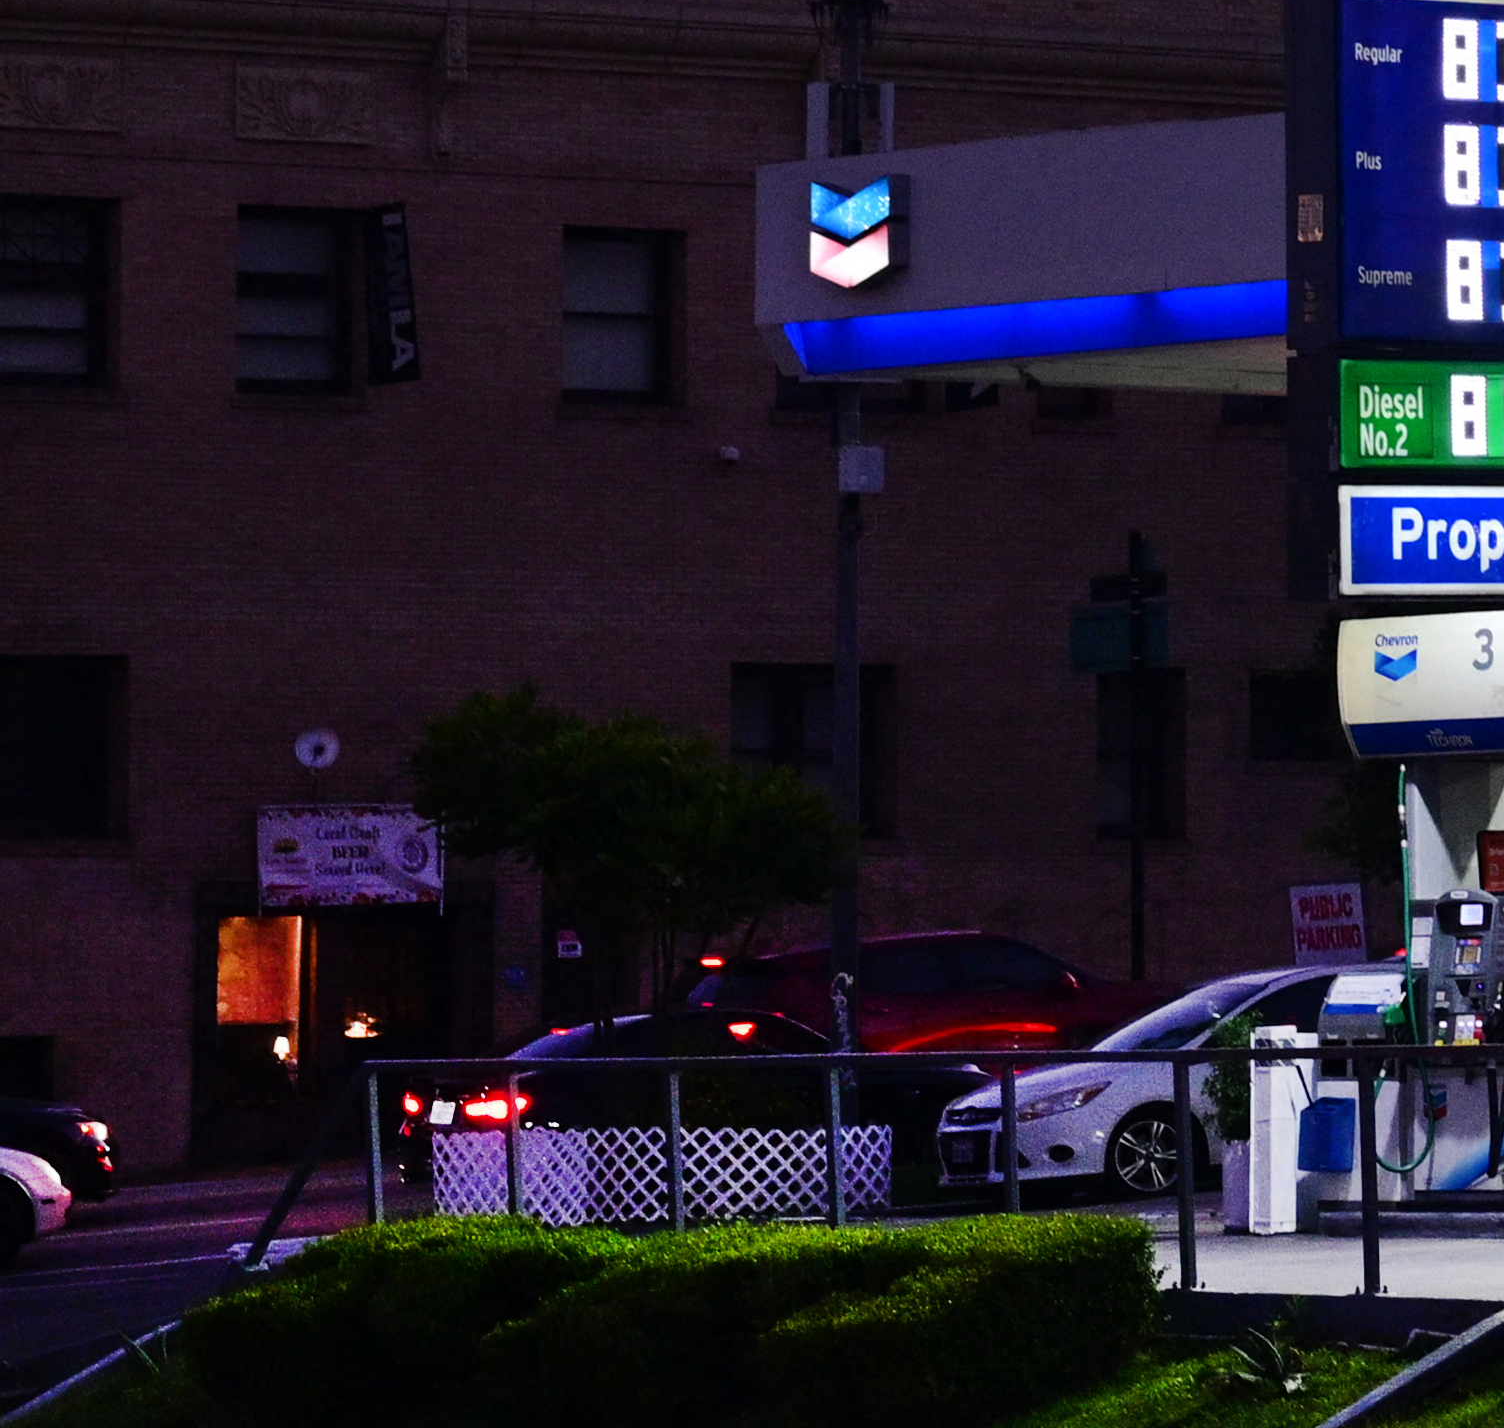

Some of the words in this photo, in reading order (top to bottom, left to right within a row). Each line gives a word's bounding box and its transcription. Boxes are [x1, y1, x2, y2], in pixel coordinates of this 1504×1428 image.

[1354, 43, 1403, 65] Regular
[1355, 151, 1382, 171] Plus
[1357, 266, 1413, 287] Supreme
[1358, 384, 1424, 419] Diesel
[1360, 422, 1409, 457] No.2
[1374, 633, 1419, 647] Chevron
[1472, 628, 1495, 671] 3
[331, 845, 368, 859] BEER
[1298, 892, 1353, 921] PUBLIC
[1296, 924, 1363, 952] PARKING
